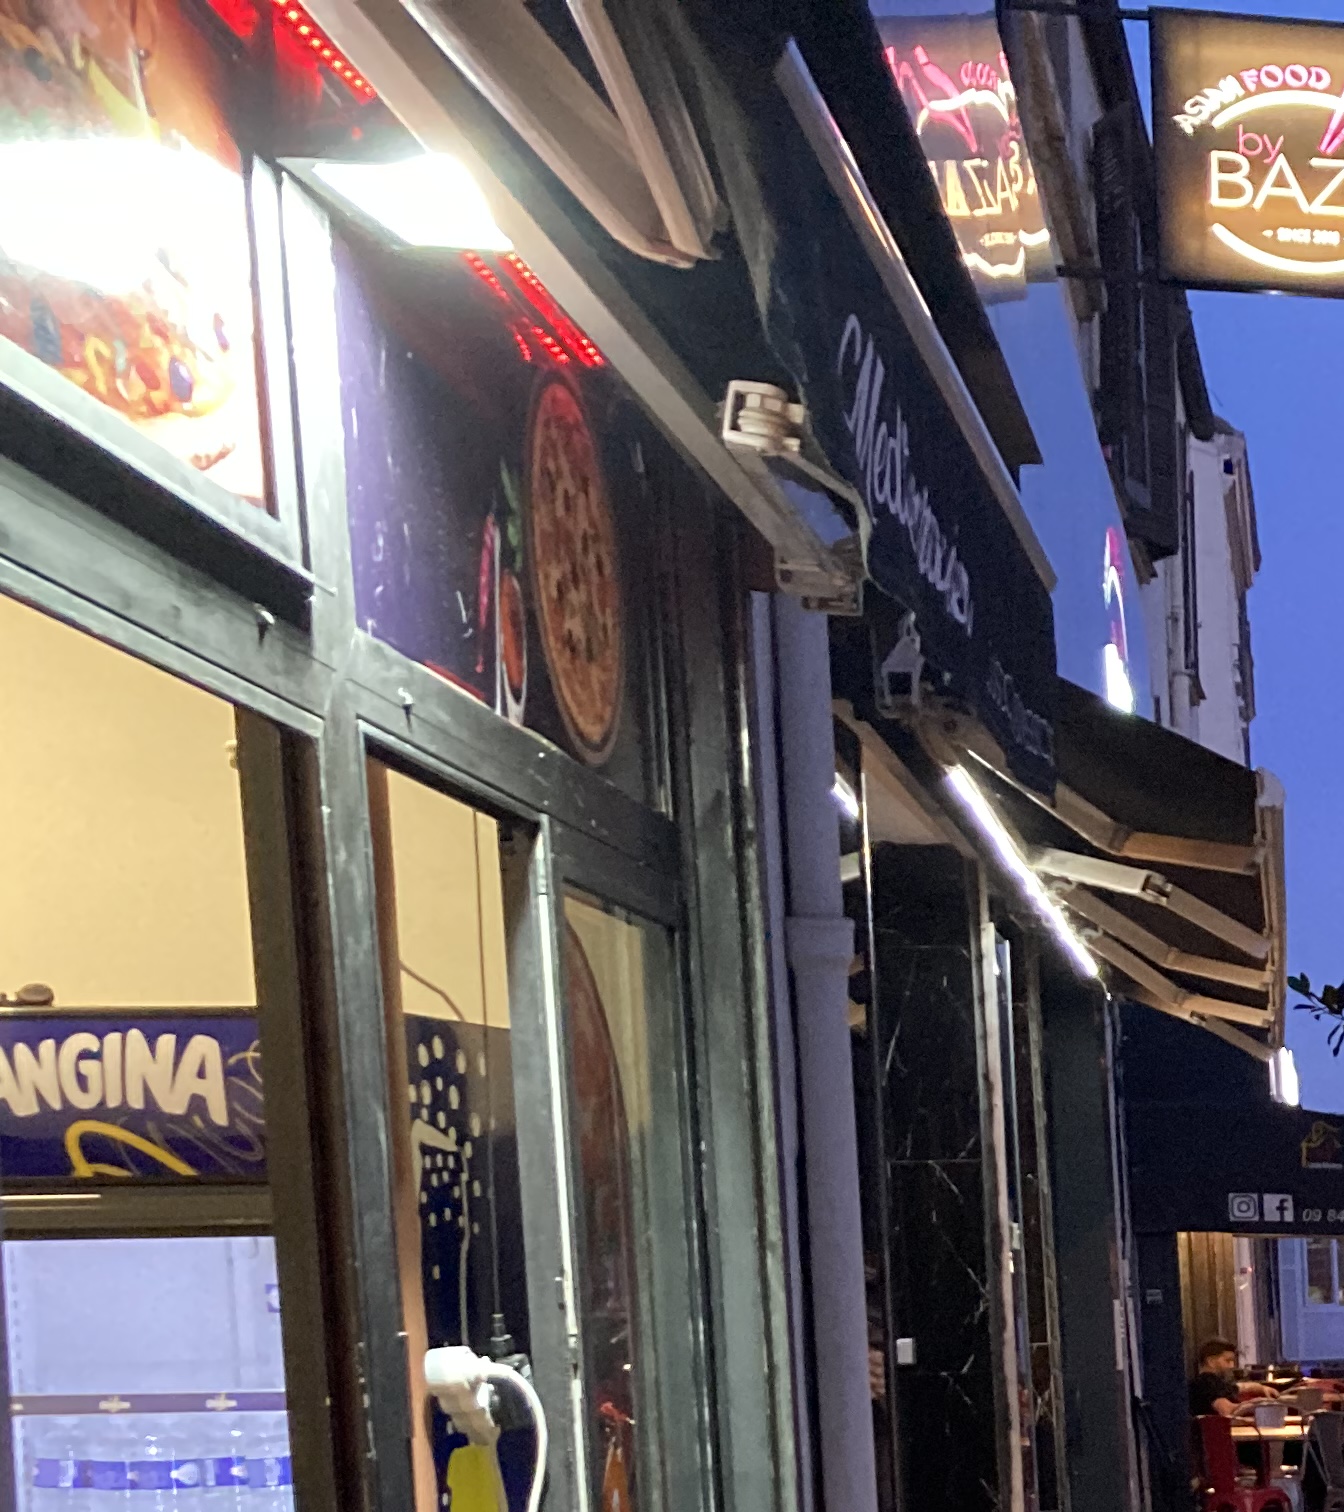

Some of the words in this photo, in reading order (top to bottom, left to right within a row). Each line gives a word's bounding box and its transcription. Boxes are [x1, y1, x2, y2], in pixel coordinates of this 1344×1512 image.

[1240, 64, 1331, 92] FOOD
[1238, 124, 1284, 163] by
[1302, 1208, 1322, 1222] 09
